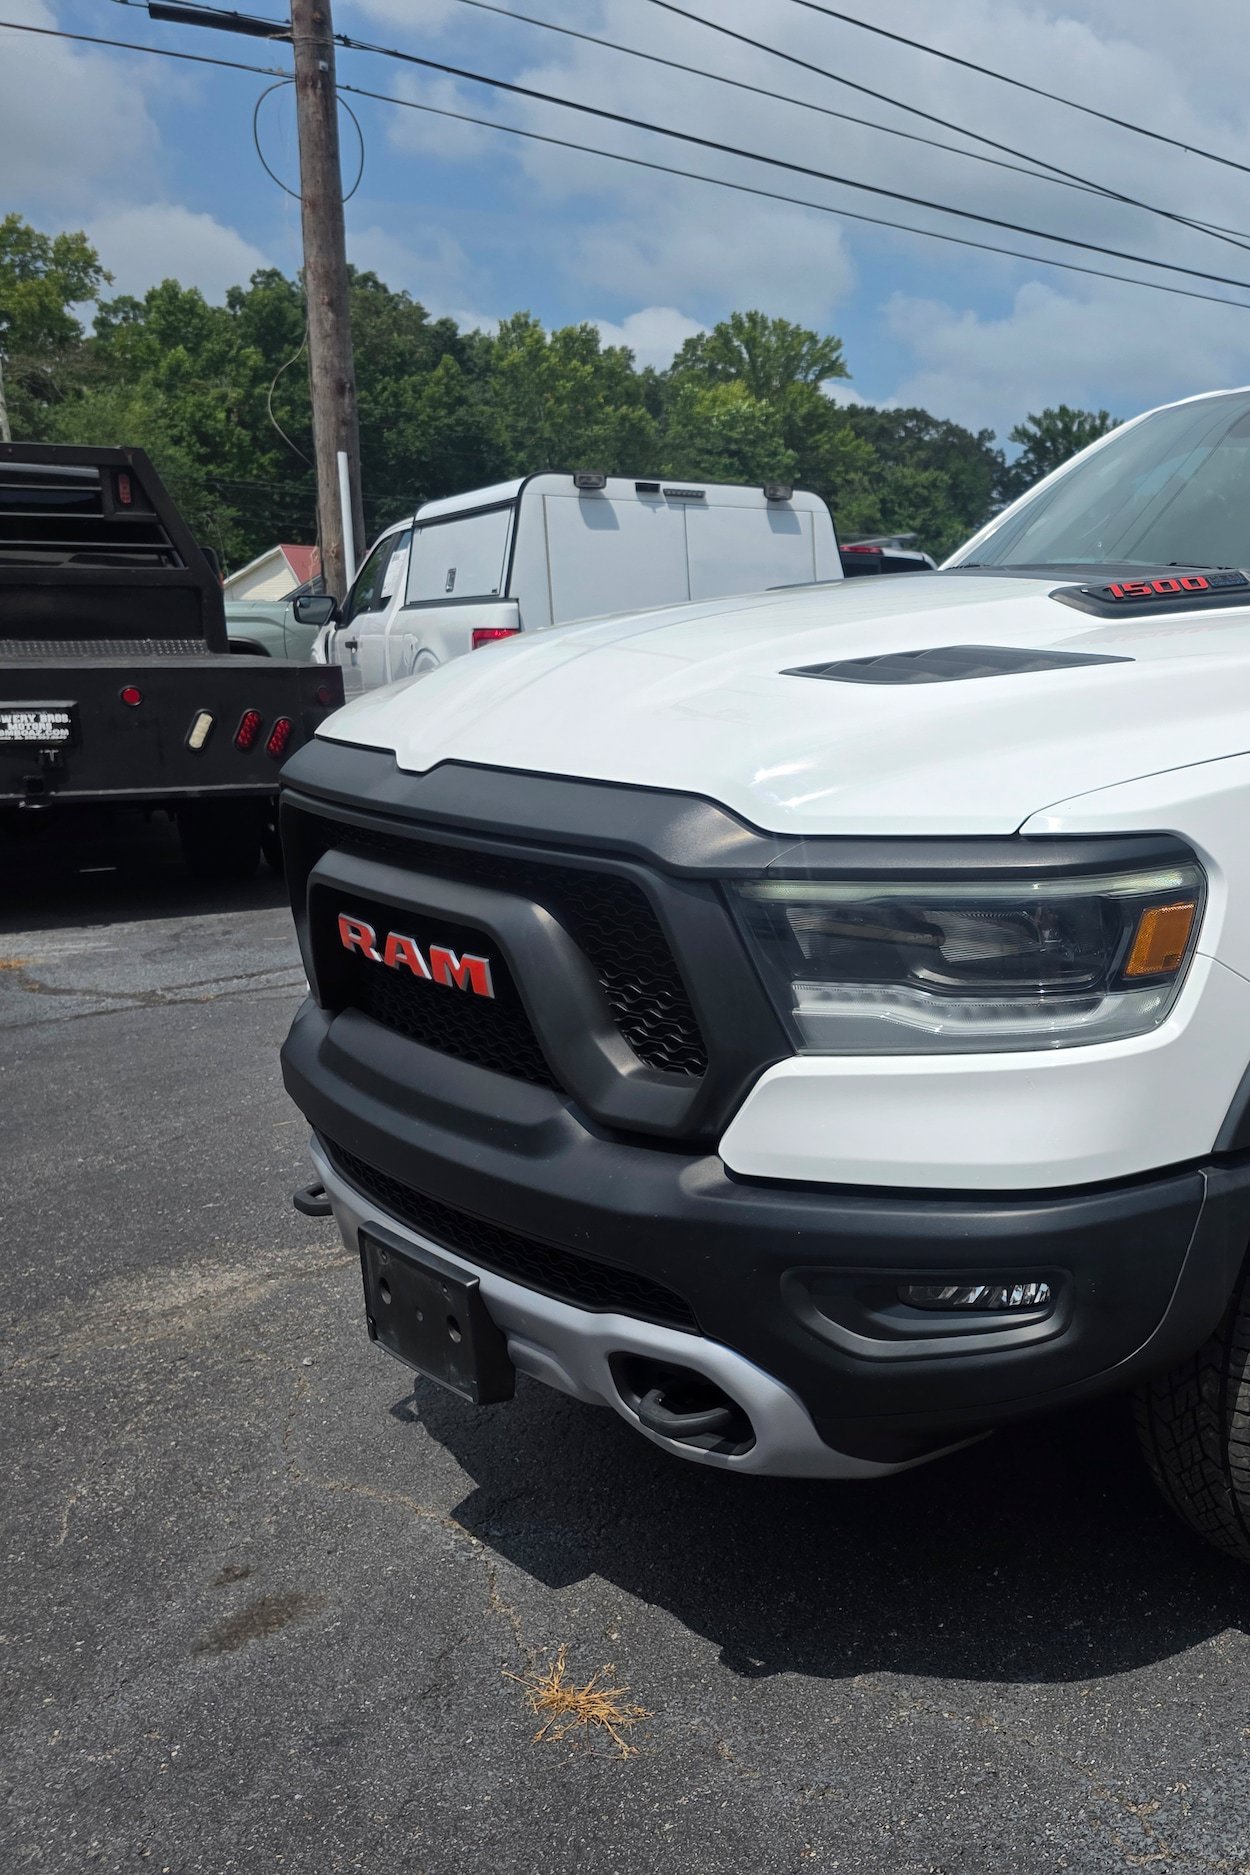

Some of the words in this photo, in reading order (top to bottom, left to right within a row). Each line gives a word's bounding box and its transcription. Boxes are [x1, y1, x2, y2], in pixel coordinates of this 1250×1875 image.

[1105, 575, 1209, 599] 1500
[0, 714, 36, 723] WERY
[7, 722, 53, 731] MOTORS
[338, 912, 495, 999] RAM
